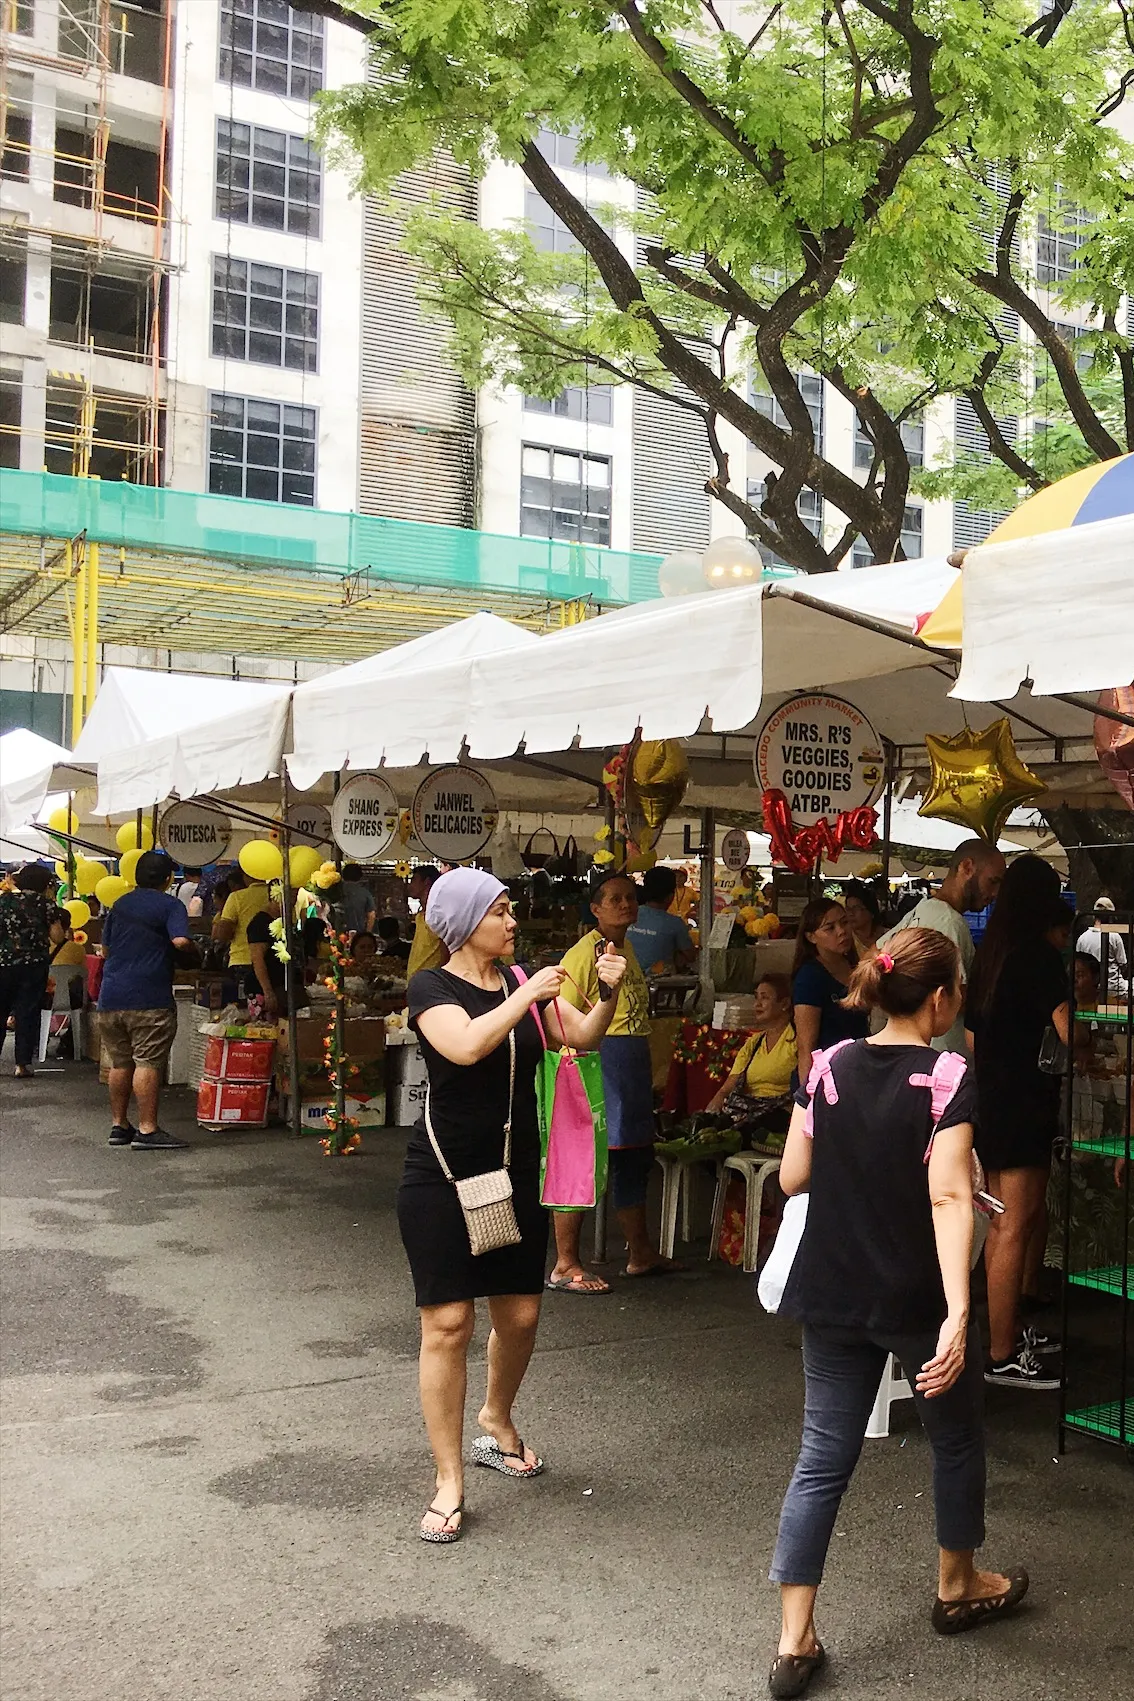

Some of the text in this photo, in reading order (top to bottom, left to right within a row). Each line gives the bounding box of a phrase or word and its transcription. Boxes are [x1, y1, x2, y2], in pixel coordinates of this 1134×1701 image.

[759, 697, 864, 787] SALCEDO COMMUNITY MARKET
[785, 721, 852, 745] MRS. R'S
[781, 744, 854, 773] VEGGIES,
[782, 768, 852, 792] GOODIES
[348, 798, 380, 817] SHANG
[434, 791, 475, 813] JANWEL
[791, 793, 842, 814] ATBP...
[168, 824, 217, 843] FRUTESCA
[342, 818, 383, 838] EXPRESS
[424, 813, 483, 835] DELICACIES
